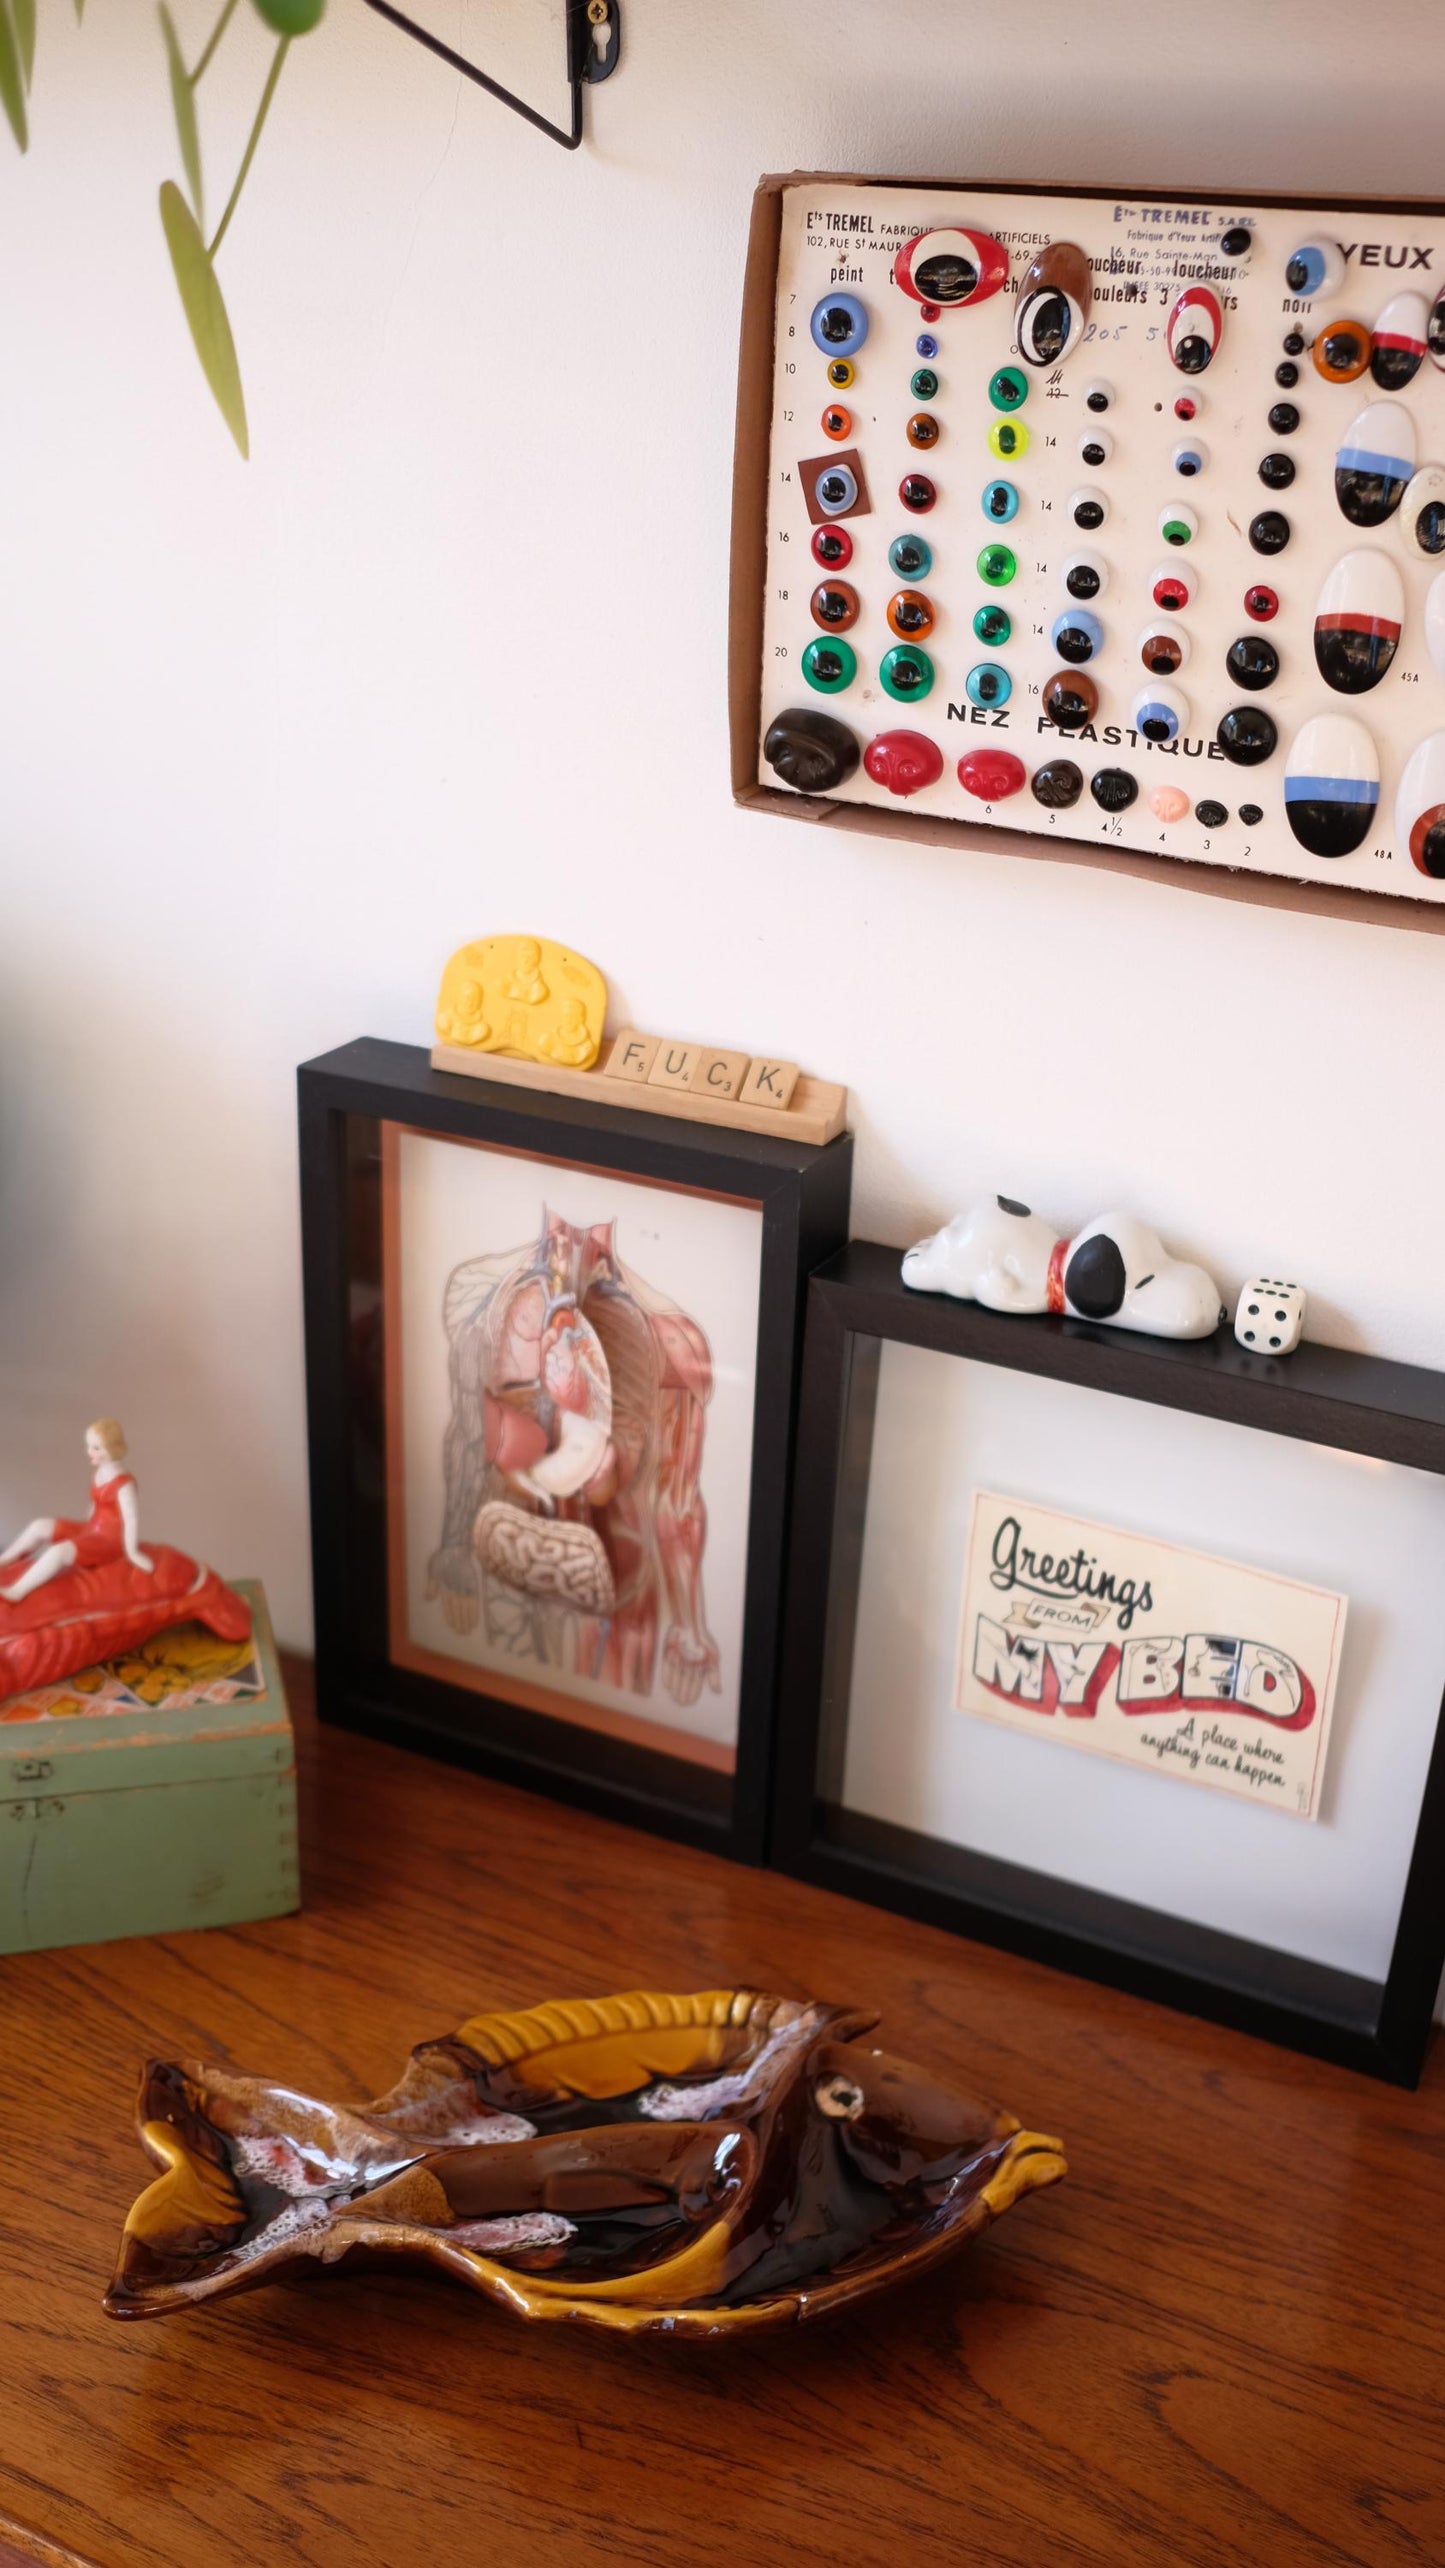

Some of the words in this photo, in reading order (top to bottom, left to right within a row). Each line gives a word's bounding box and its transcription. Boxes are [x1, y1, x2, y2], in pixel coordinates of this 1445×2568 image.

[826, 213, 874, 233] TREMEL
[1141, 208, 1212, 226] TREMEL
[830, 237, 849, 249] RUE
[1130, 248, 1149, 259] Rue
[1336, 243, 1434, 270] YEUX
[1086, 256, 1141, 275] oucheur
[1173, 259, 1236, 280] loucheur
[830, 265, 864, 284] peint
[789, 294, 797, 305] 7
[1093, 285, 1148, 304] ouleurs
[1159, 287, 1169, 305] 3
[788, 326, 796, 338] 8
[784, 363, 797, 375] 10
[782, 410, 795, 422] 12
[1044, 436, 1057, 448] 14
[780, 472, 792, 483] 14
[1040, 500, 1053, 511] 14
[778, 531, 790, 543] 16
[1035, 562, 1048, 573] 14
[777, 589, 789, 601] 18
[1032, 624, 1044, 635] 14
[774, 646, 788, 658] 20
[1027, 683, 1040, 695] 16
[946, 702, 1011, 729] NEZ
[1037, 716, 1225, 761] PLASTQUE
[984, 804, 993, 815] 6
[1048, 814, 1057, 825] 5
[1158, 831, 1167, 843] 4
[1203, 838, 1212, 850] 3
[1243, 845, 1252, 858] 2
[989, 1516, 1153, 1631] Greetings
[1032, 1604, 1093, 1629] FROM
[973, 1613, 1120, 1717] MY
[1116, 1633, 1316, 1733] BED
[1176, 1717, 1196, 1741] A
[1201, 1724, 1239, 1748] place
[1243, 1738, 1285, 1764] where
[1140, 1732, 1201, 1769] anything
[1205, 1753, 1230, 1770] can
